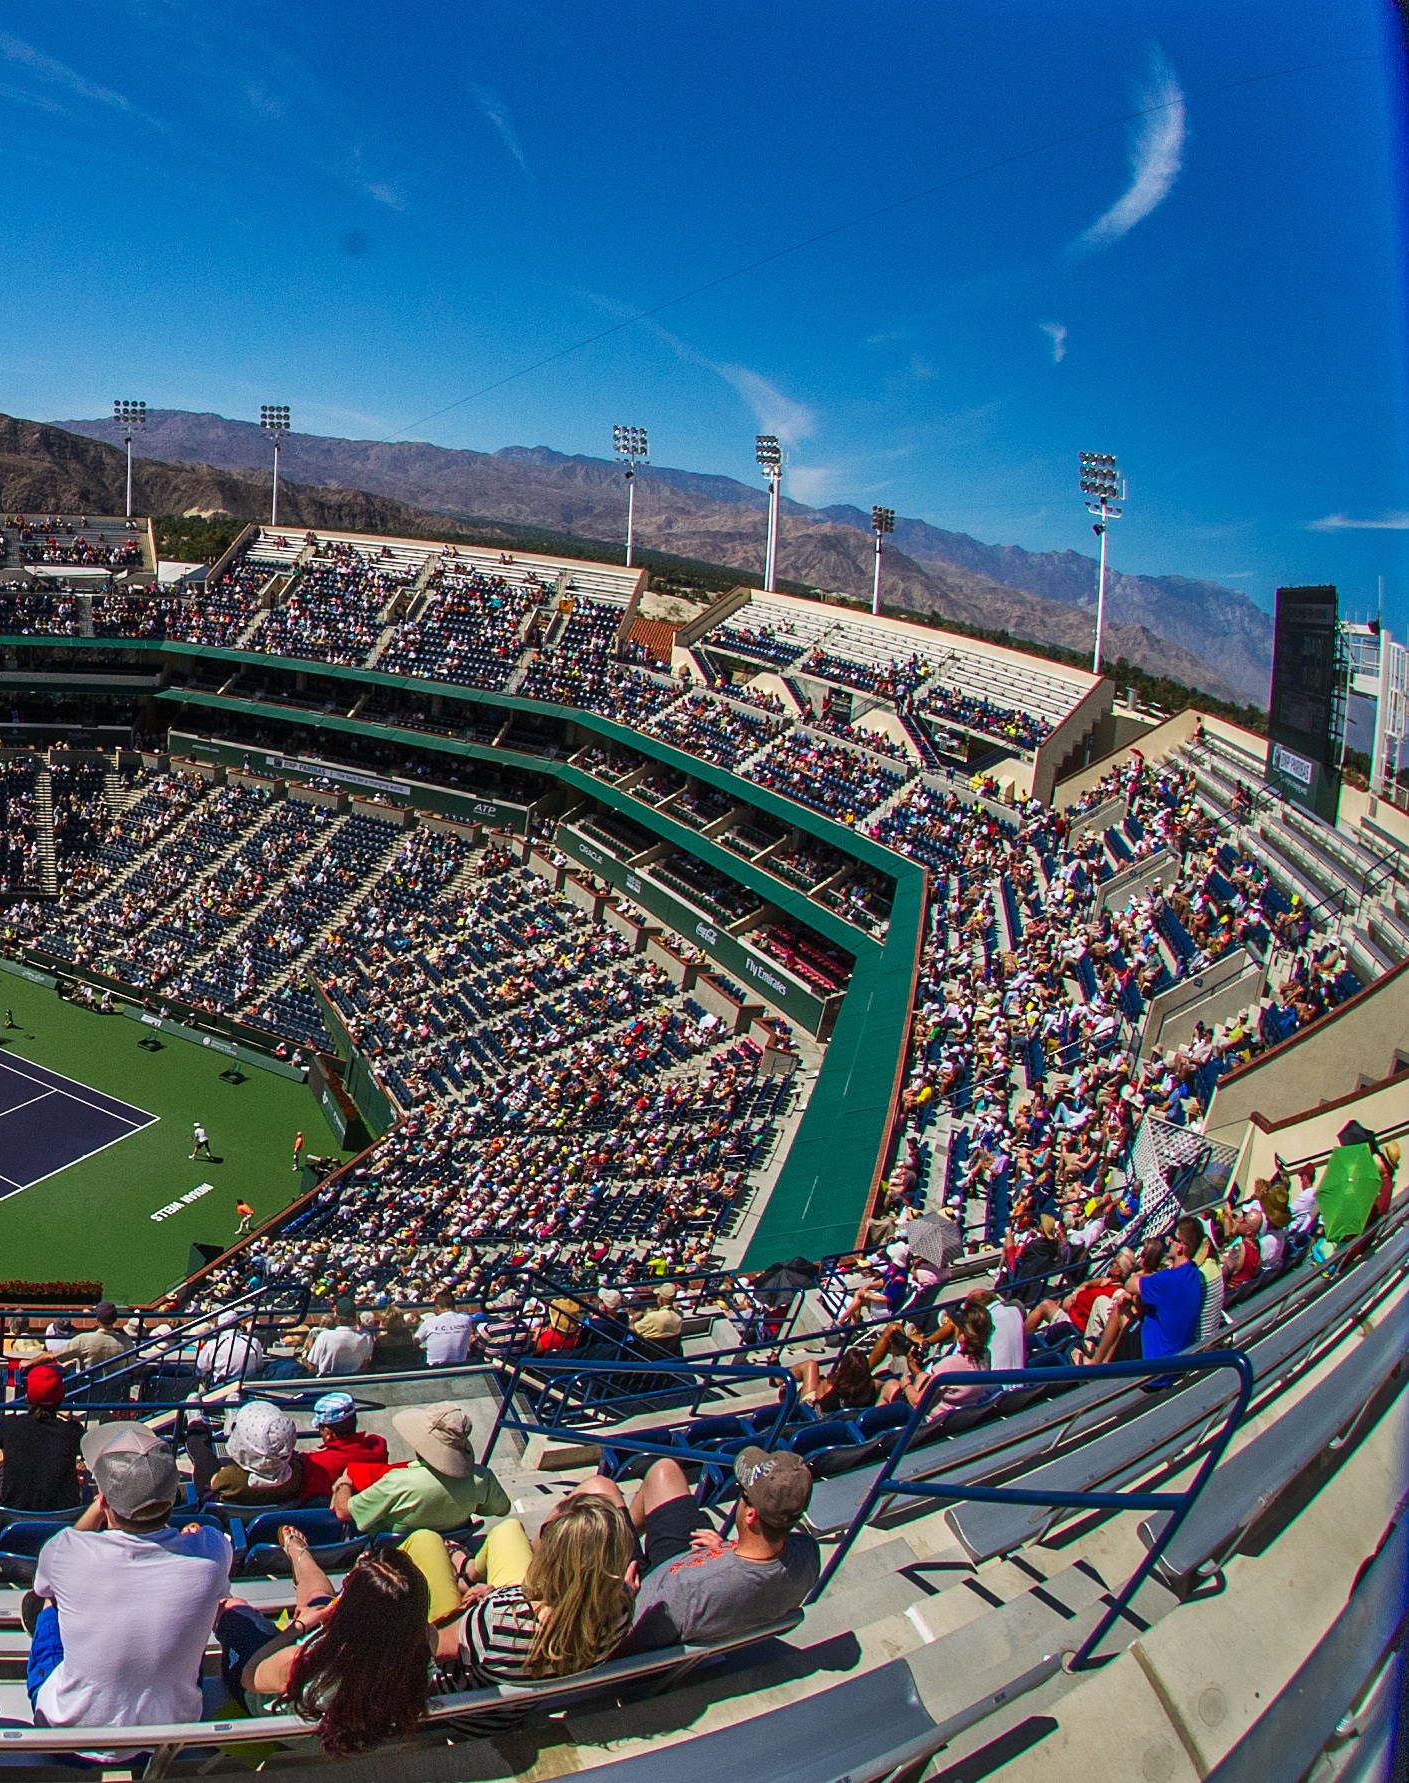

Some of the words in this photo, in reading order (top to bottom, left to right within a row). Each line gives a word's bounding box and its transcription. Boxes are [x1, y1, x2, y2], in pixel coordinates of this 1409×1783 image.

[283, 759, 298, 769] BNP
[298, 764, 326, 777] PARIBAS
[474, 803, 497, 813] ATP
[745, 957, 759, 977] Fly
[757, 965, 787, 996] Emirates
[179, 1182, 214, 1204] INDIAN
[150, 1201, 185, 1222] WELLS
